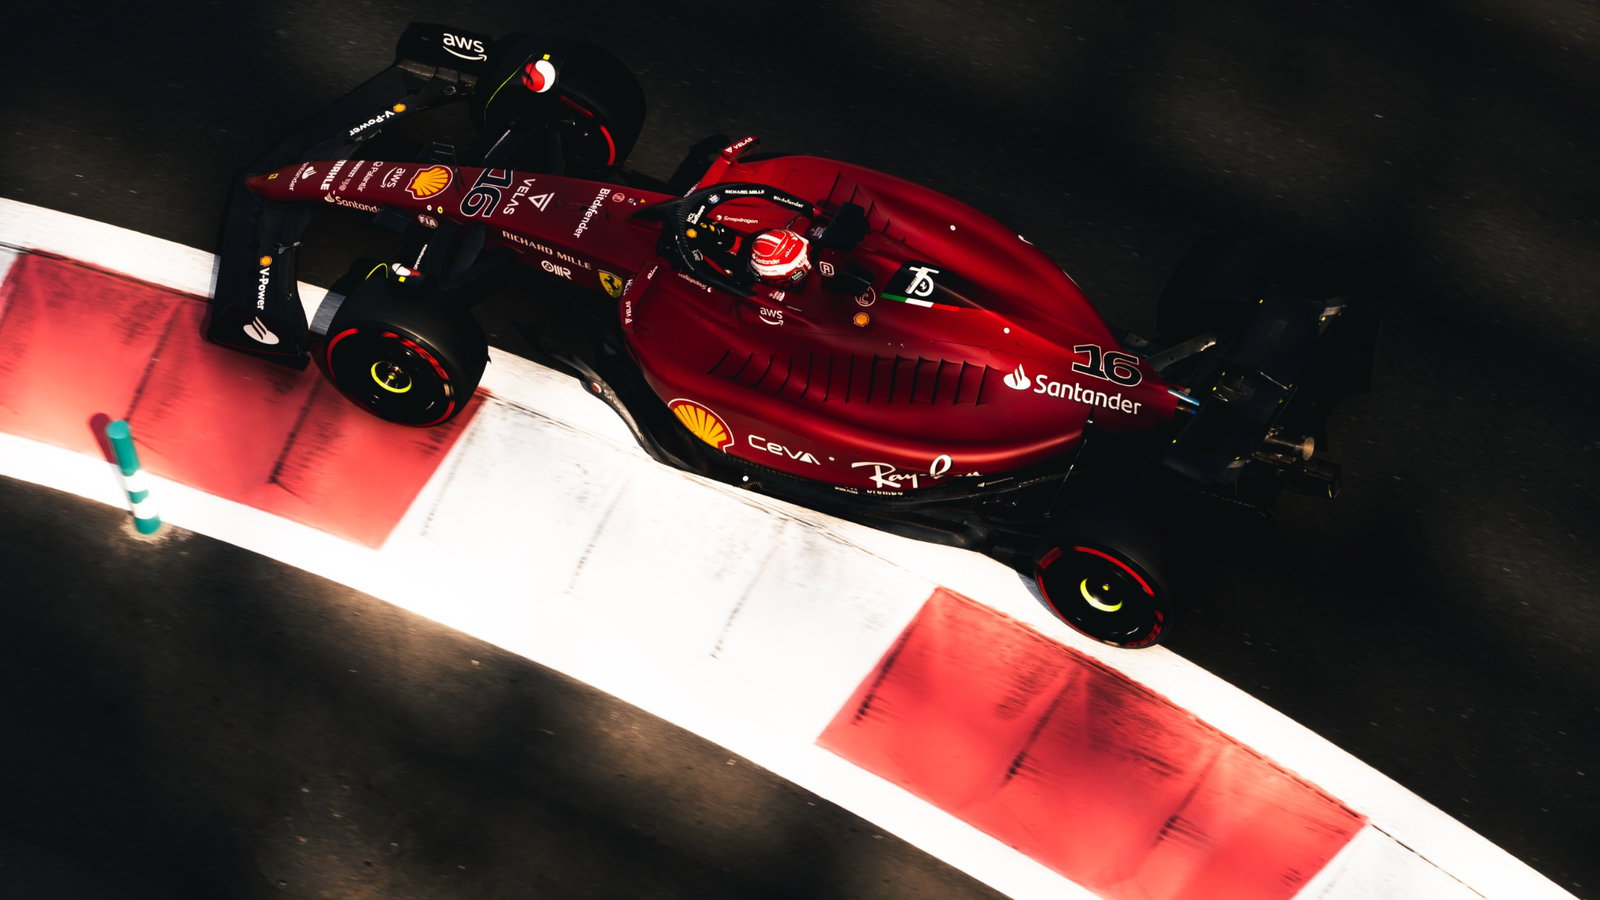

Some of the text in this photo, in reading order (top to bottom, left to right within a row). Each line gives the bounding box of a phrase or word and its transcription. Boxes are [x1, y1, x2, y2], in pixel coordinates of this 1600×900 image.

[442, 32, 485, 54] aws
[349, 110, 395, 136] V-Power
[733, 137, 753, 150] VELAS
[386, 167, 406, 189] aws
[334, 195, 381, 214] Santand
[502, 178, 536, 215] VELAS
[573, 187, 611, 239] Bitdefender
[723, 215, 759, 224] Snapdragon
[501, 230, 593, 271] RICHARD MILLE
[256, 267, 271, 311] V-Power
[759, 306, 783, 320] aws
[1071, 343, 1143, 387] 16
[1033, 374, 1142, 415] Santander
